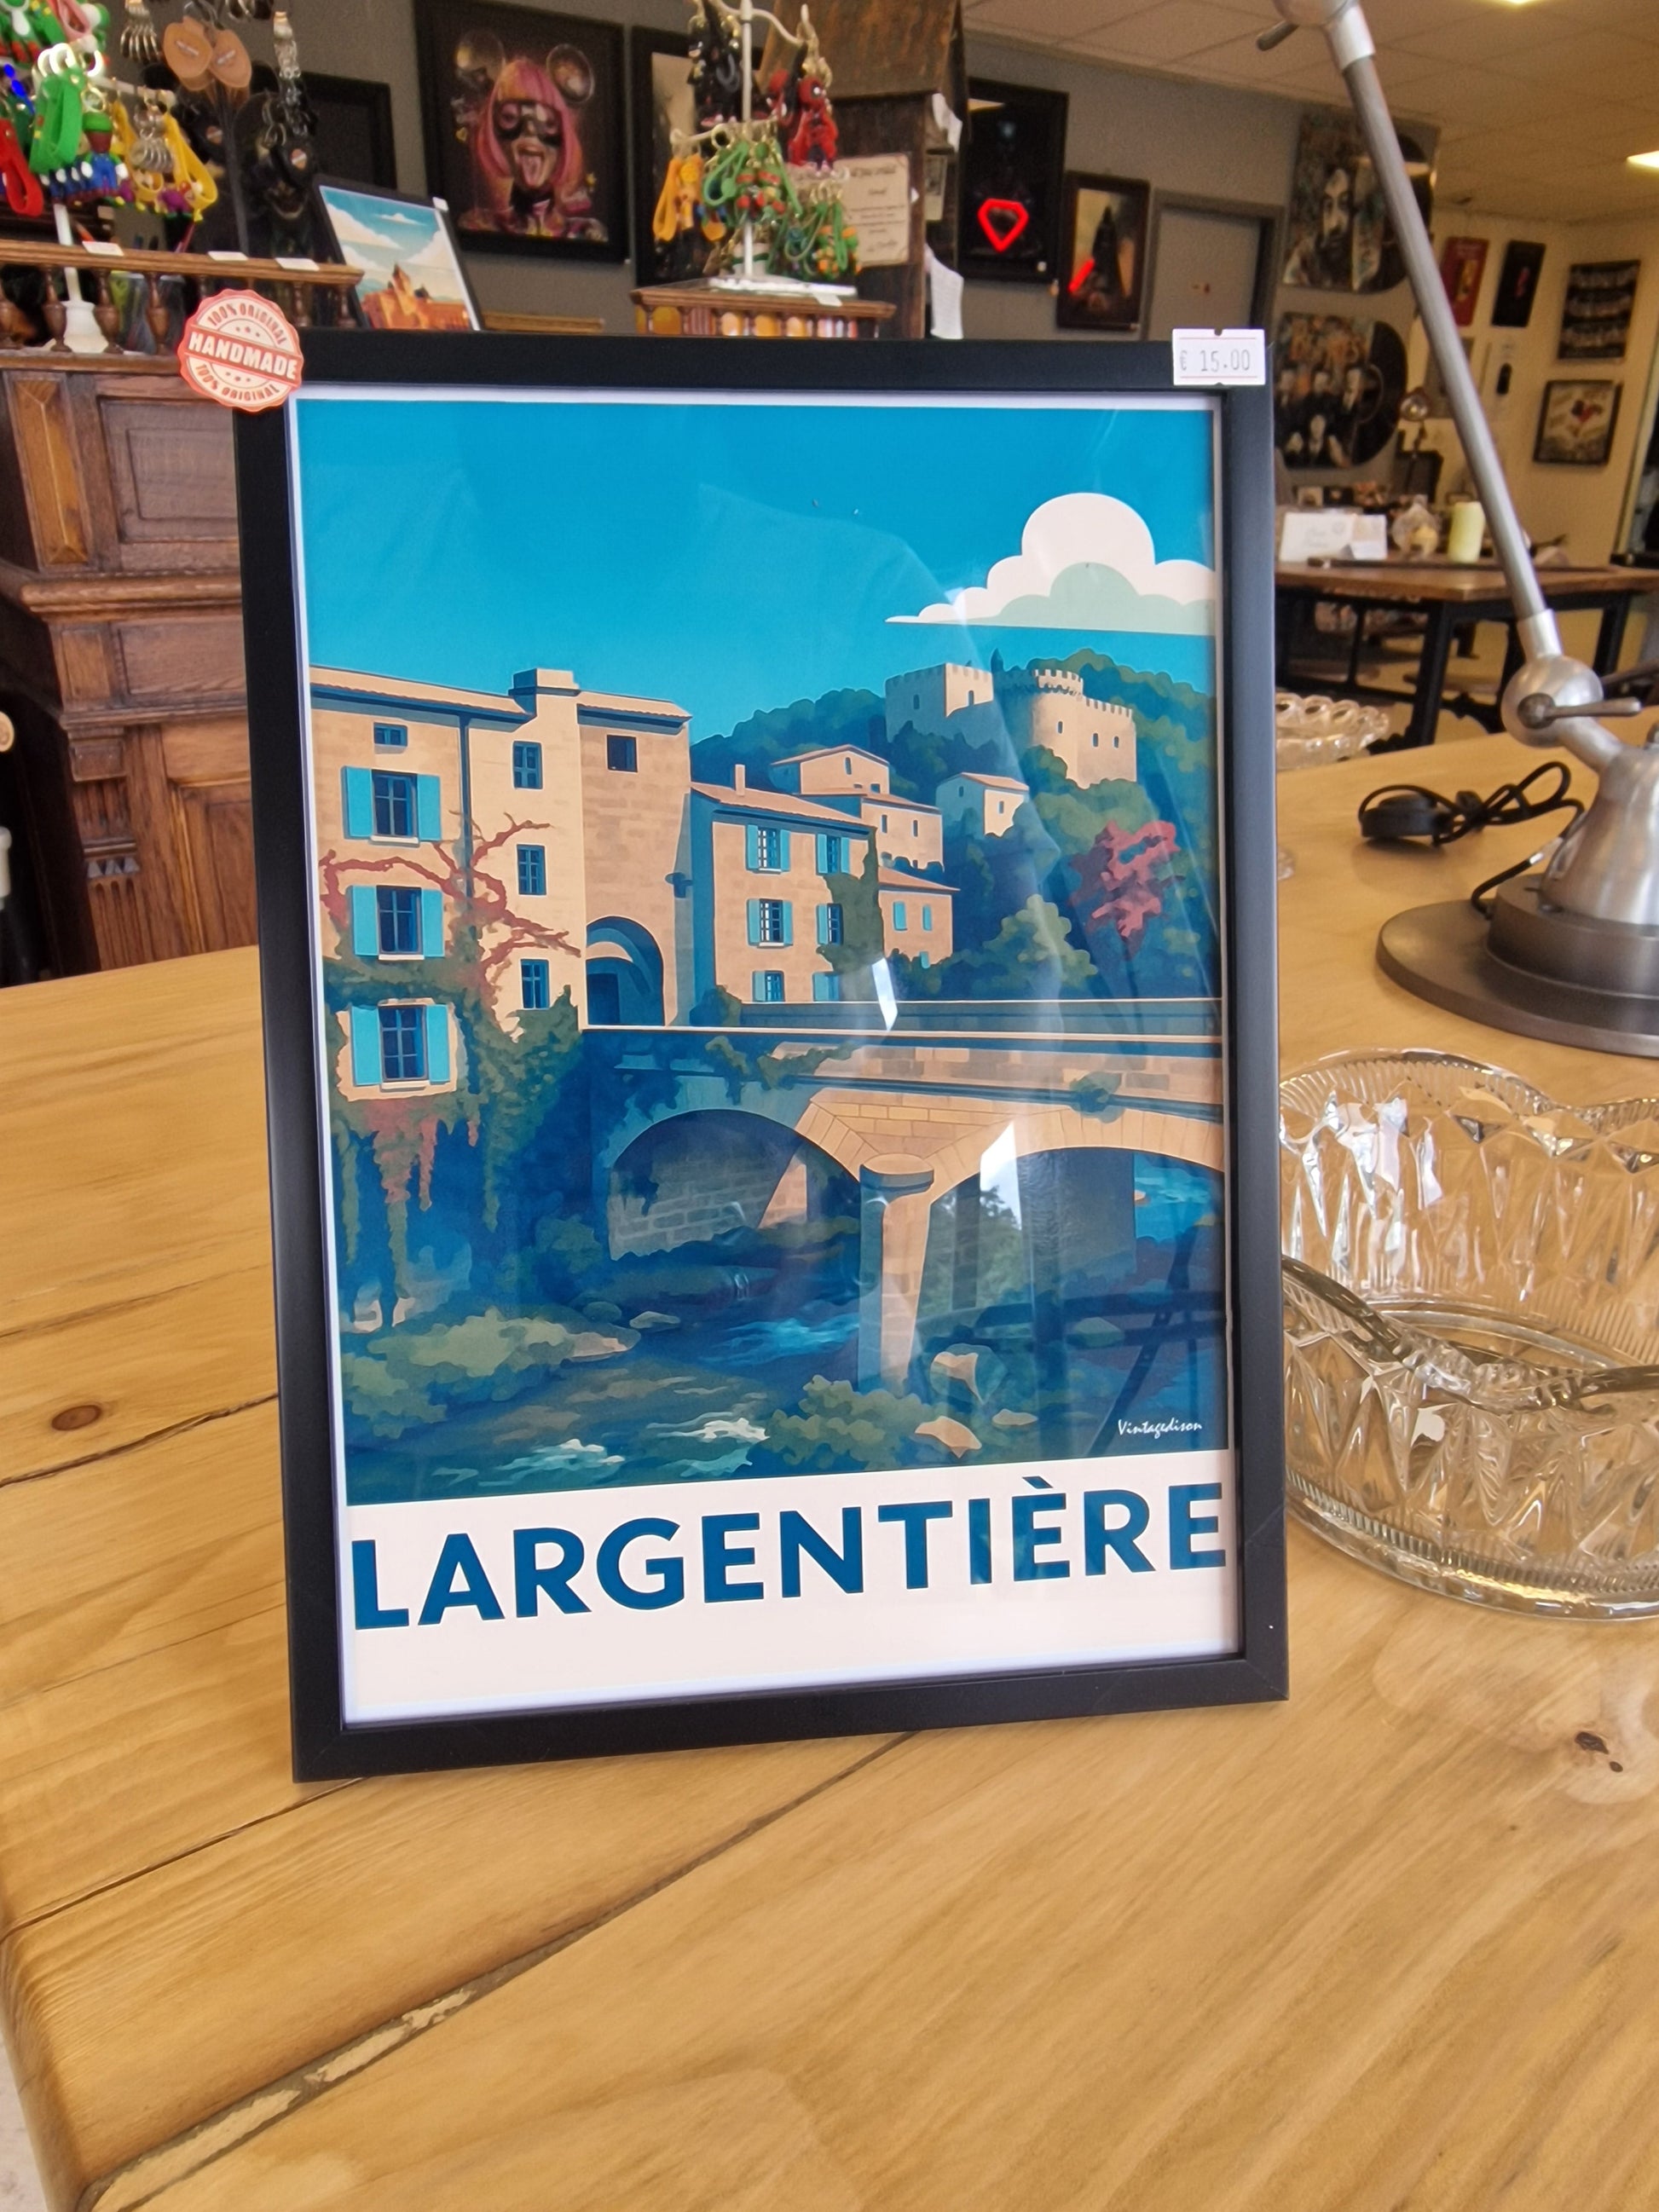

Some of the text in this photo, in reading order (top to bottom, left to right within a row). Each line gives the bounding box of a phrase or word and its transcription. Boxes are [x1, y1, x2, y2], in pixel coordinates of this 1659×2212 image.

[207, 303, 287, 345] 100% ORIGINAL
[188, 332, 298, 380] HANDMADE
[1199, 349, 1251, 373] 15.00
[195, 364, 280, 401] 100% ORIGINAL
[1118, 1417, 1203, 1439] Vintagedison
[351, 1476, 1226, 1631] LARGENTIÈRE
